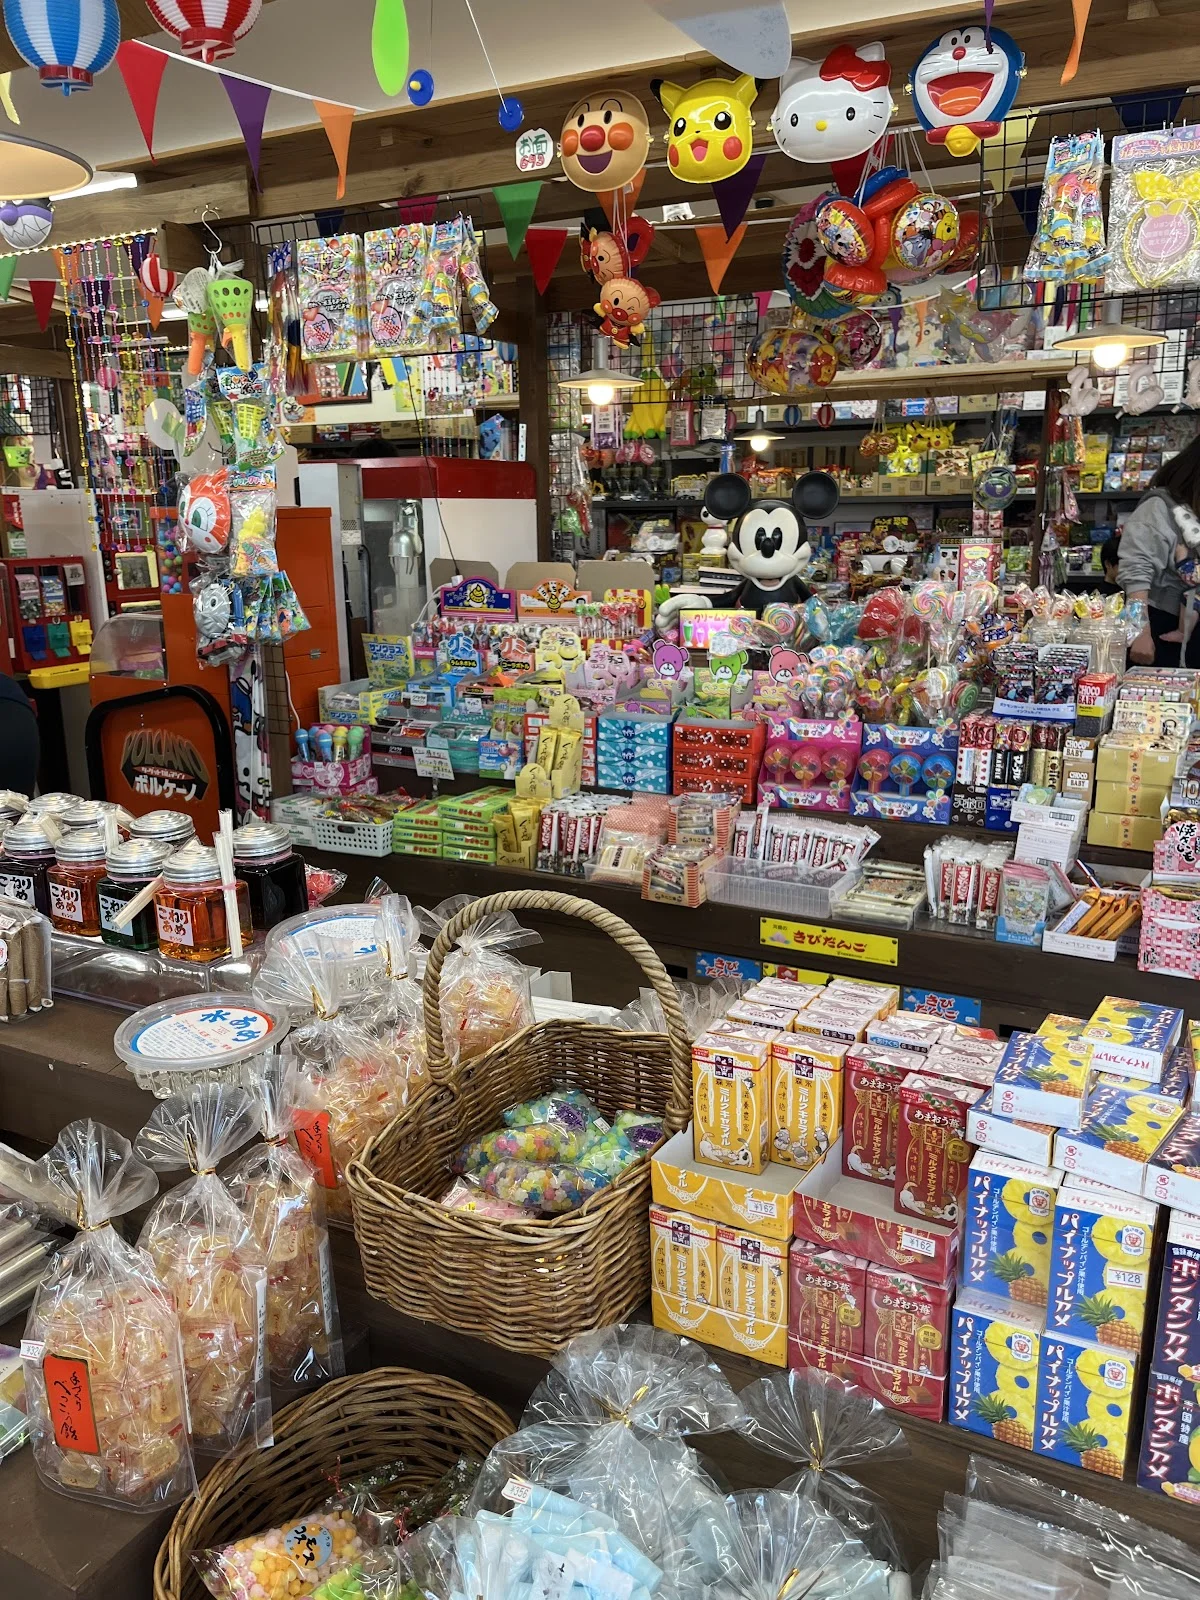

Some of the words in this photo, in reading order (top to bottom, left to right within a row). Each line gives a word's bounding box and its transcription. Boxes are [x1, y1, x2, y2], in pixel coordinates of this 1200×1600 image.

[520, 134, 548, 156] お面
[520, 154, 545, 169] 693
[694, 613, 735, 622] クリームソー
[560, 638, 575, 646] チョコ
[608, 656, 623, 664] チョコ
[1078, 686, 1100, 696] CHOCO
[1078, 695, 1097, 705] BABY
[121, 729, 210, 784] VOLCANO
[1066, 748, 1083, 757] BABY
[134, 775, 197, 802] ボルケーノ
[1070, 779, 1085, 787] BABY
[51, 885, 79, 901] こねり
[55, 900, 77, 913] あめ
[158, 907, 189, 925] こねり
[162, 923, 187, 936] あめ
[793, 930, 868, 953] きびだんご
[714, 958, 739, 970] きび
[925, 994, 954, 1008] きび
[915, 1004, 958, 1020] だんご
[200, 1009, 262, 1042] 水あめ
[876, 1037, 899, 1048] あけくち
[1093, 1052, 1150, 1070] パイナップルア
[720, 1087, 731, 1147] ミルクキャラメル
[798, 1087, 809, 1147] ミルクキャラメル
[914, 1109, 961, 1128] あまおう苺
[984, 1158, 1049, 1178] パイナップルアメ
[754, 1203, 774, 1213] ¥162
[1071, 1196, 1142, 1215] パイナップルアメ
[970, 1176, 991, 1283] パイナップルアメ
[909, 1237, 932, 1251] ¥162
[1054, 1213, 1080, 1327] パイナップルアメ
[1076, 1226, 1090, 1295] ゴールデンパイン果汁使用
[676, 1254, 688, 1315] ミルクキャラメル
[804, 1273, 851, 1294] あまおう苺
[1115, 1271, 1141, 1284] ¥128
[745, 1272, 757, 1336] ミルクキャラメル
[882, 1294, 932, 1316] あまおう苺
[1164, 1256, 1200, 1363] ボンタンアメ
[923, 1330, 936, 1339] 期間
[955, 1317, 974, 1421] パイナップルアメ
[973, 1329, 983, 1393] ゴールデンパイン果汁使用
[69, 1370, 82, 1412] 手づくり
[1042, 1345, 1064, 1450] パイナップルアメ
[1061, 1358, 1074, 1423] ゴールデンパイン果汁使用
[53, 1380, 79, 1441] べっこう飴
[1147, 1383, 1181, 1481] ボンタンアメ
[509, 1482, 529, 1499] ¥356
